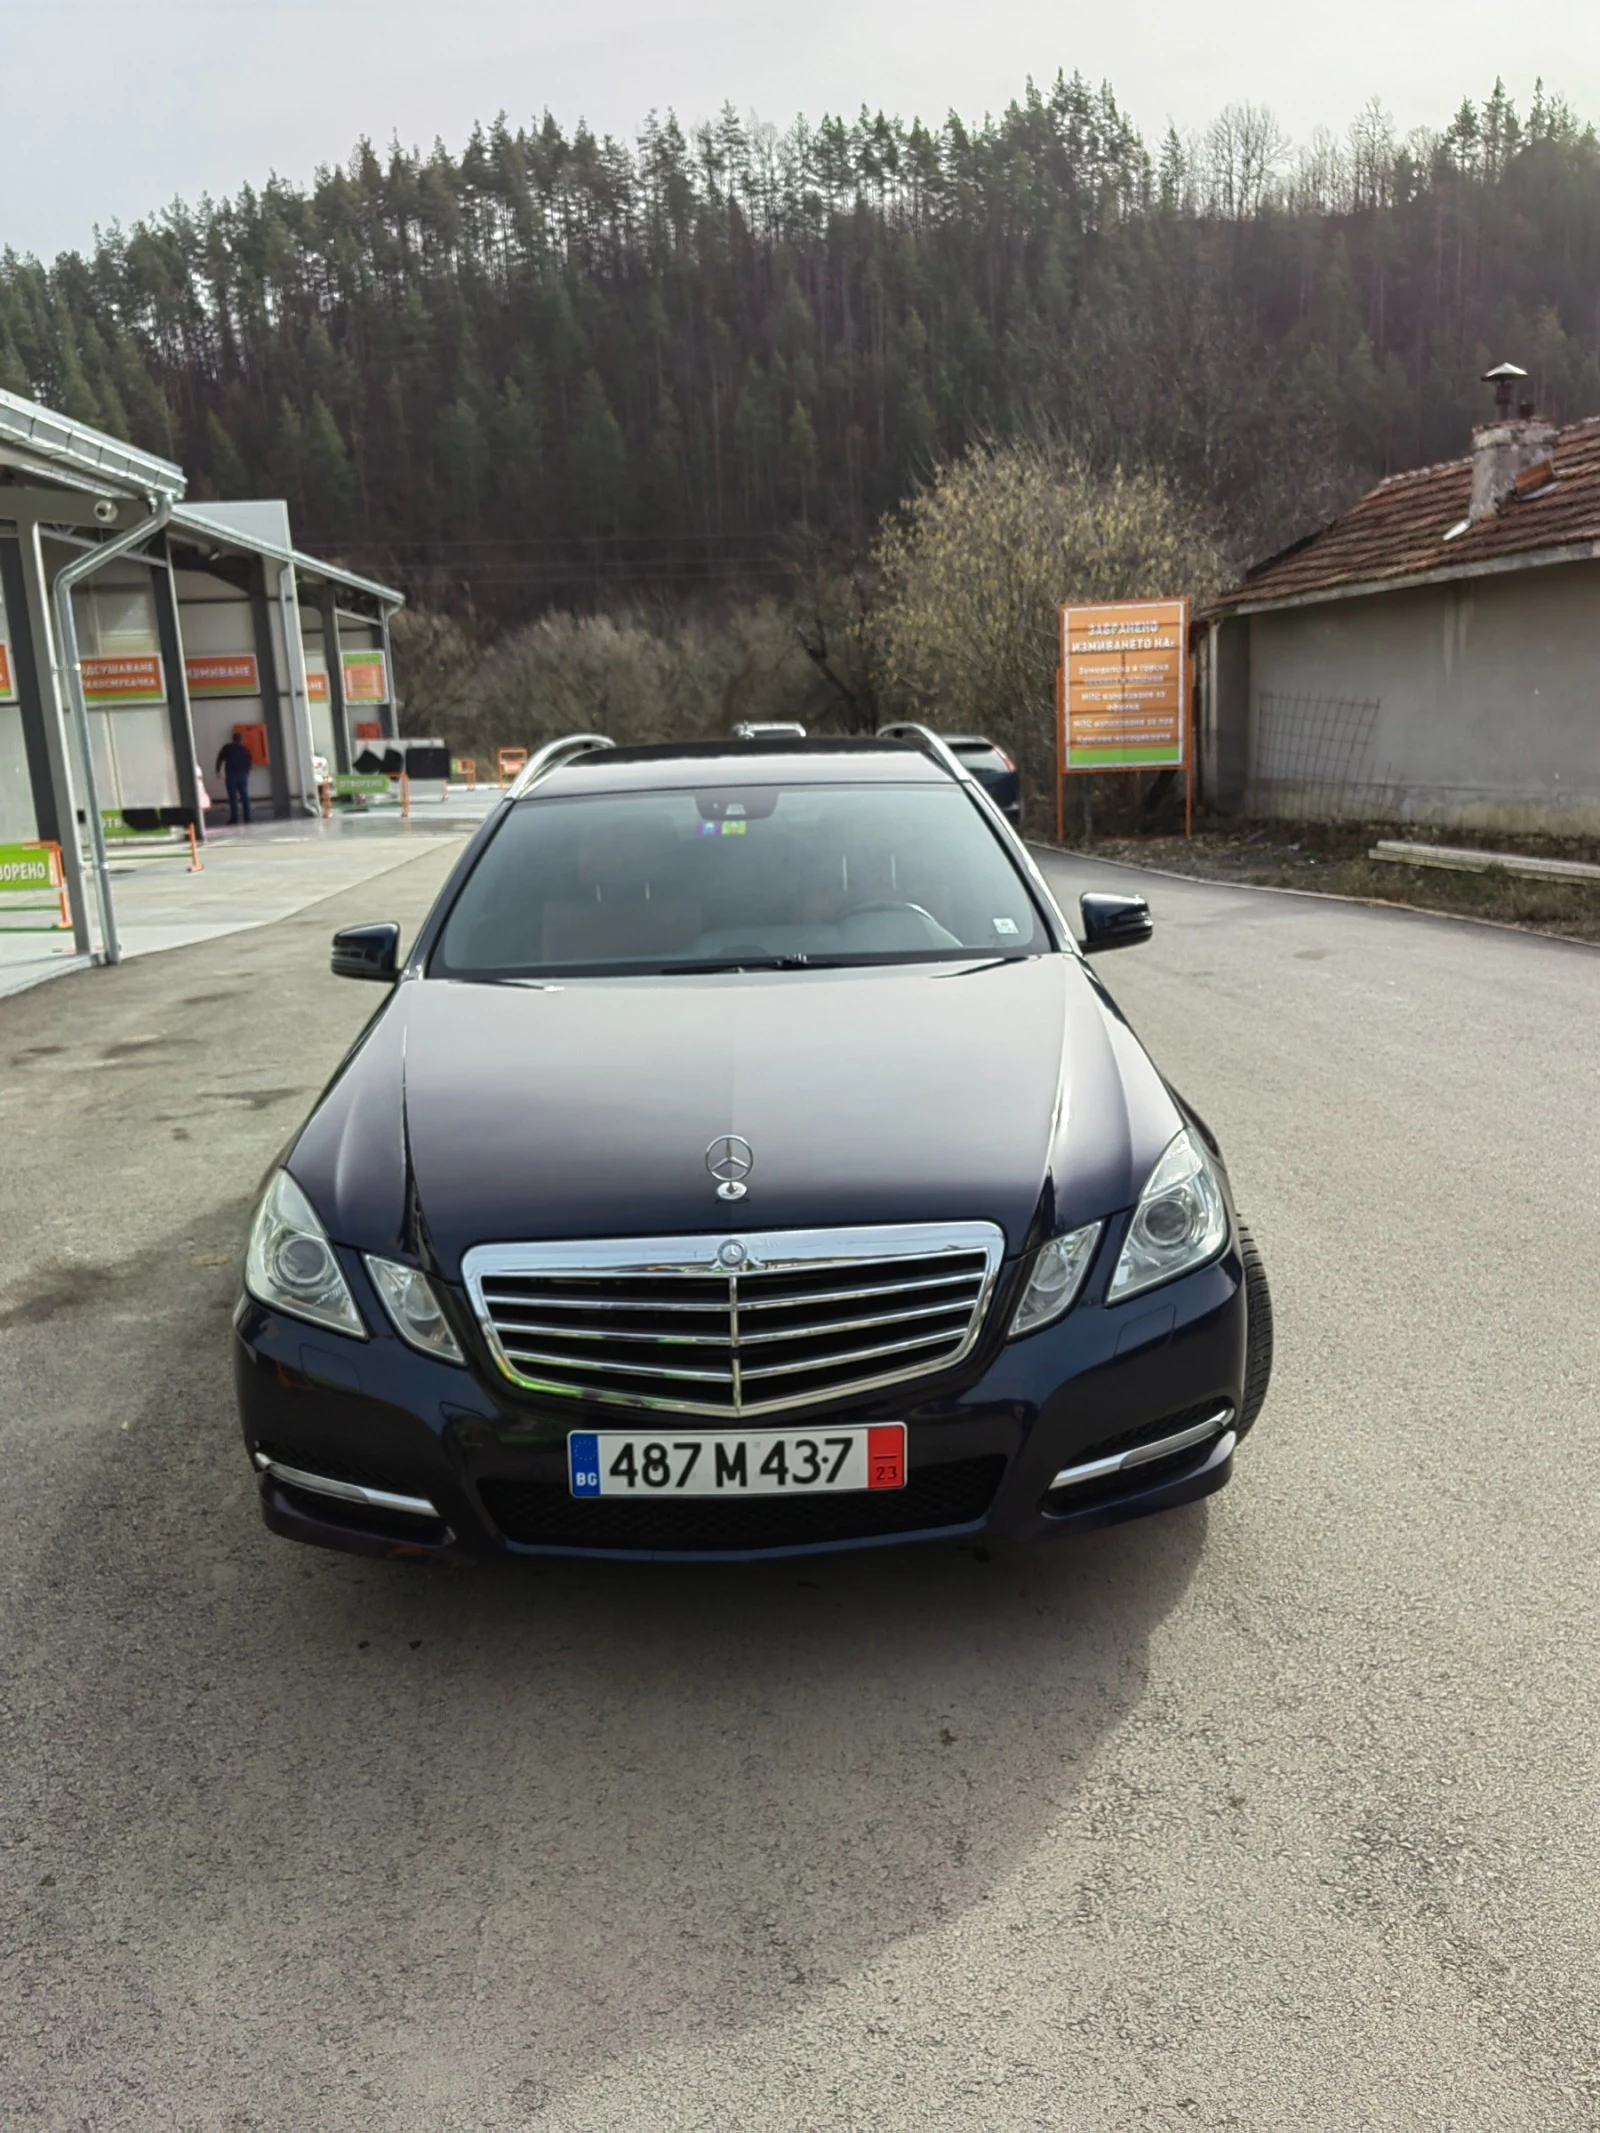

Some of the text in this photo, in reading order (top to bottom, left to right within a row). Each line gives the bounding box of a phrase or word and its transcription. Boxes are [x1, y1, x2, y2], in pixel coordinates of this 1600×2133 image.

[1087, 620, 1159, 636] ЗАБРАНЕНО
[1071, 638, 1152, 653] ИЗМИВАНЕТО
[609, 1437, 897, 1488] 487 M 437 23
[576, 1472, 598, 1487] BG
